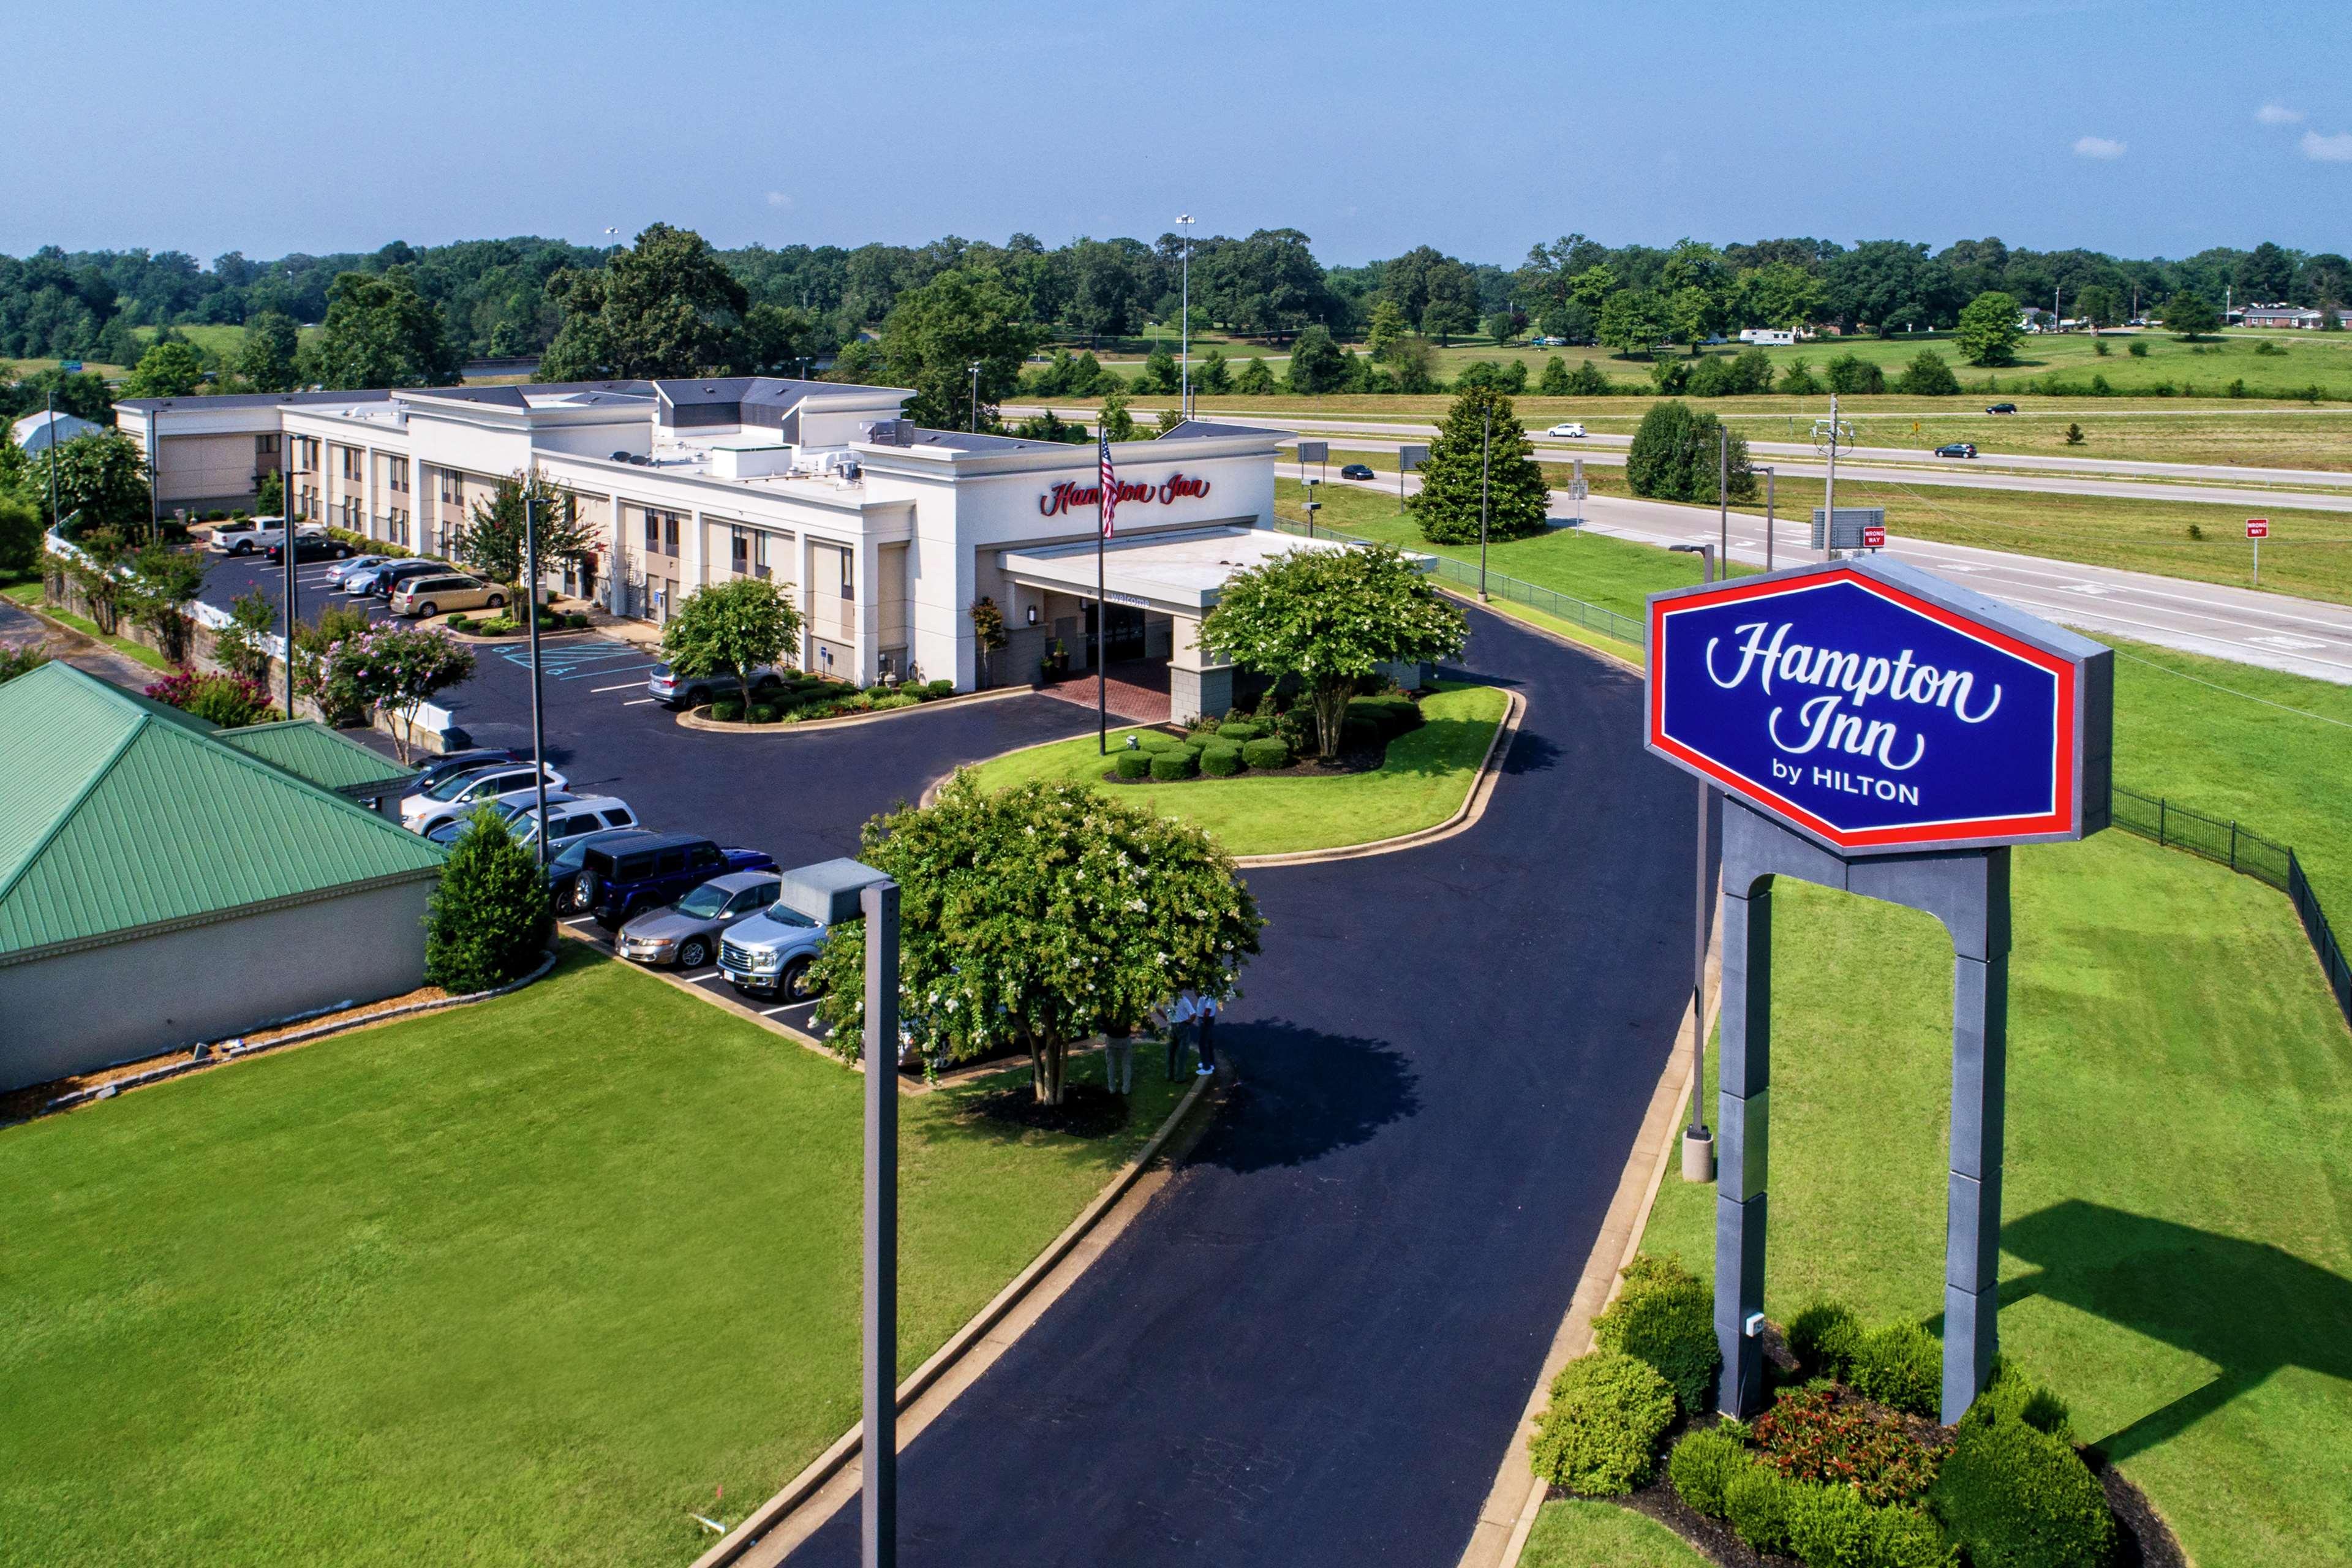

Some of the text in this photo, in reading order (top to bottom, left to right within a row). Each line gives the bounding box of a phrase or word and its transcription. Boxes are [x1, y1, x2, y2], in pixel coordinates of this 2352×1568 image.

[1041, 473, 1210, 516] Hamton Inn
[1111, 593, 1150, 608] welcome
[1706, 622, 2002, 723] Hampton
[1769, 695, 1925, 771] Inn
[1773, 758, 1919, 806] by HILTON
